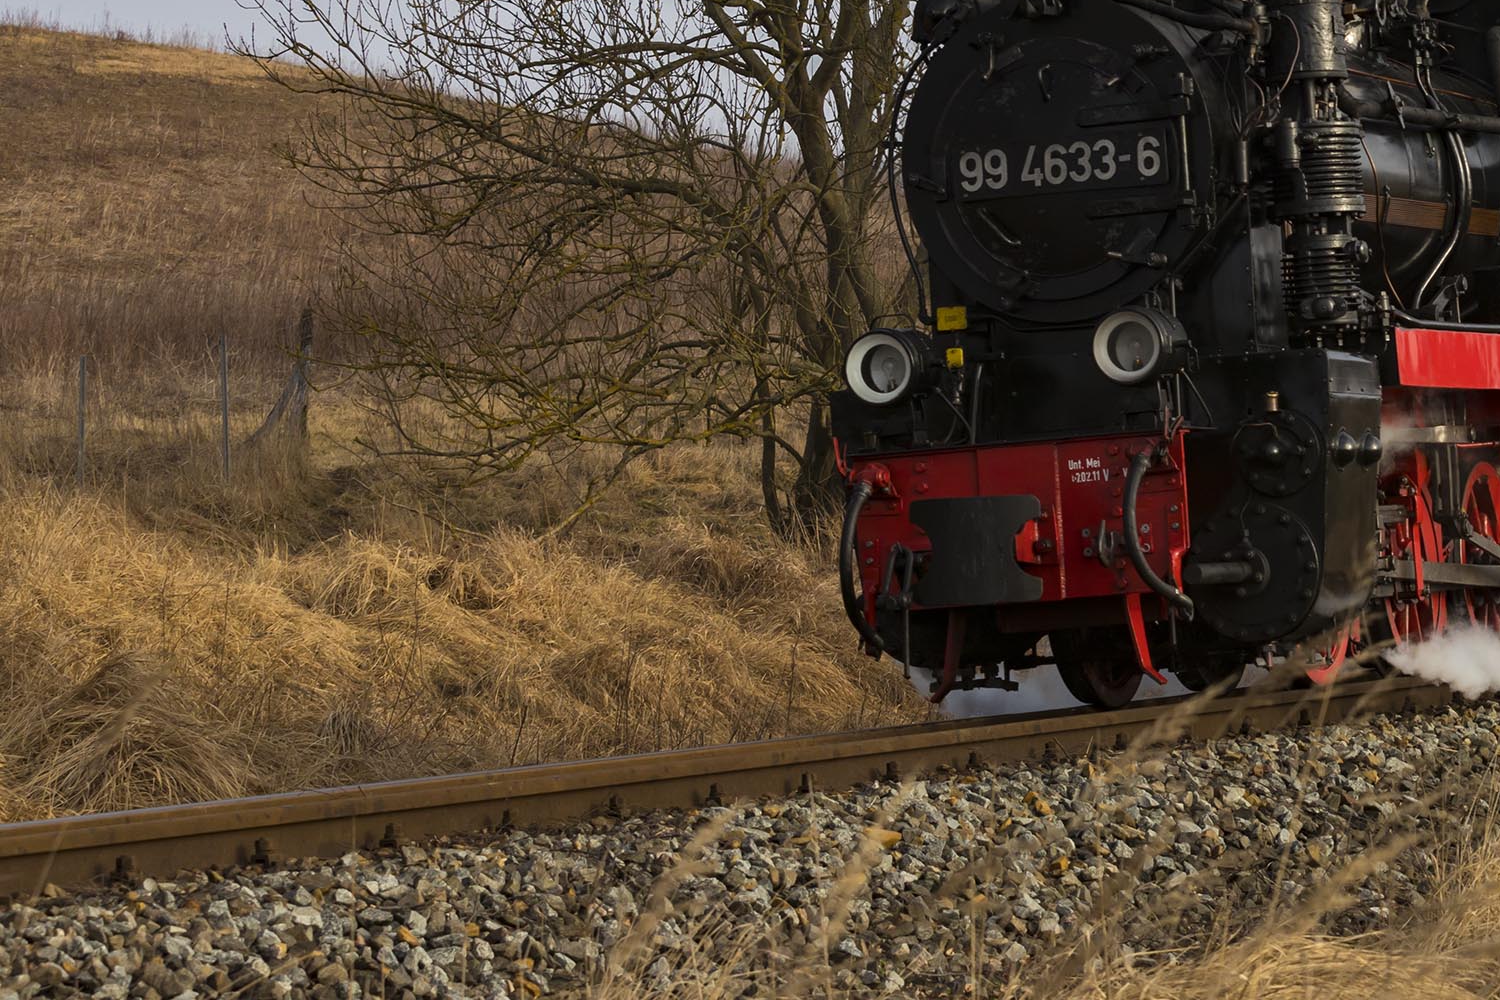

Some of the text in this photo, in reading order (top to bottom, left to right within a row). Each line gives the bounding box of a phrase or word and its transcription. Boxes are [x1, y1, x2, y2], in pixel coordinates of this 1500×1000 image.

[959, 136, 1161, 192] 99 4633-6
[1068, 459, 1085, 470] Unt.
